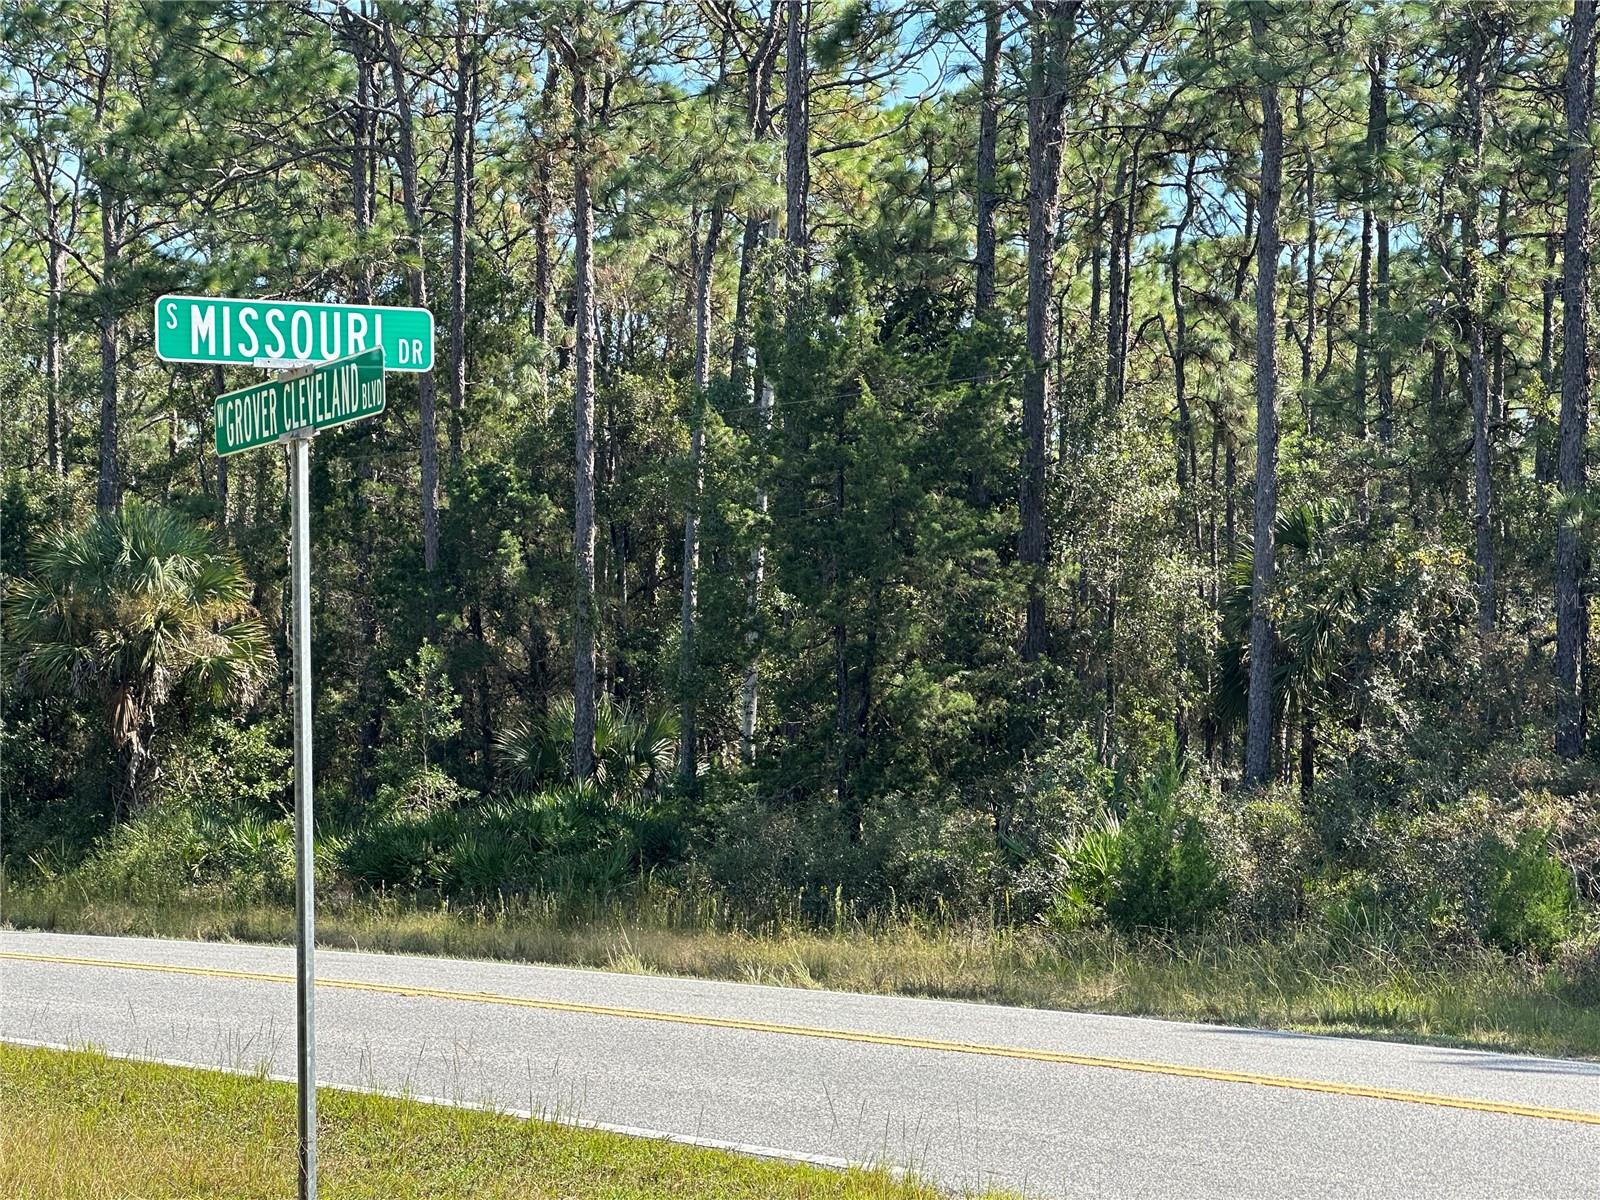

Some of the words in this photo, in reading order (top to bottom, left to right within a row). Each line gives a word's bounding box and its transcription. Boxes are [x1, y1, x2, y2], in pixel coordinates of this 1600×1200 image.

[166, 302, 178, 330] S
[190, 304, 382, 360] MISSOURI
[398, 338, 423, 365] DR
[216, 403, 224, 428] W
[226, 388, 278, 447] GROVER
[283, 363, 359, 431] CLEVELAND
[362, 378, 382, 409] BLVD
